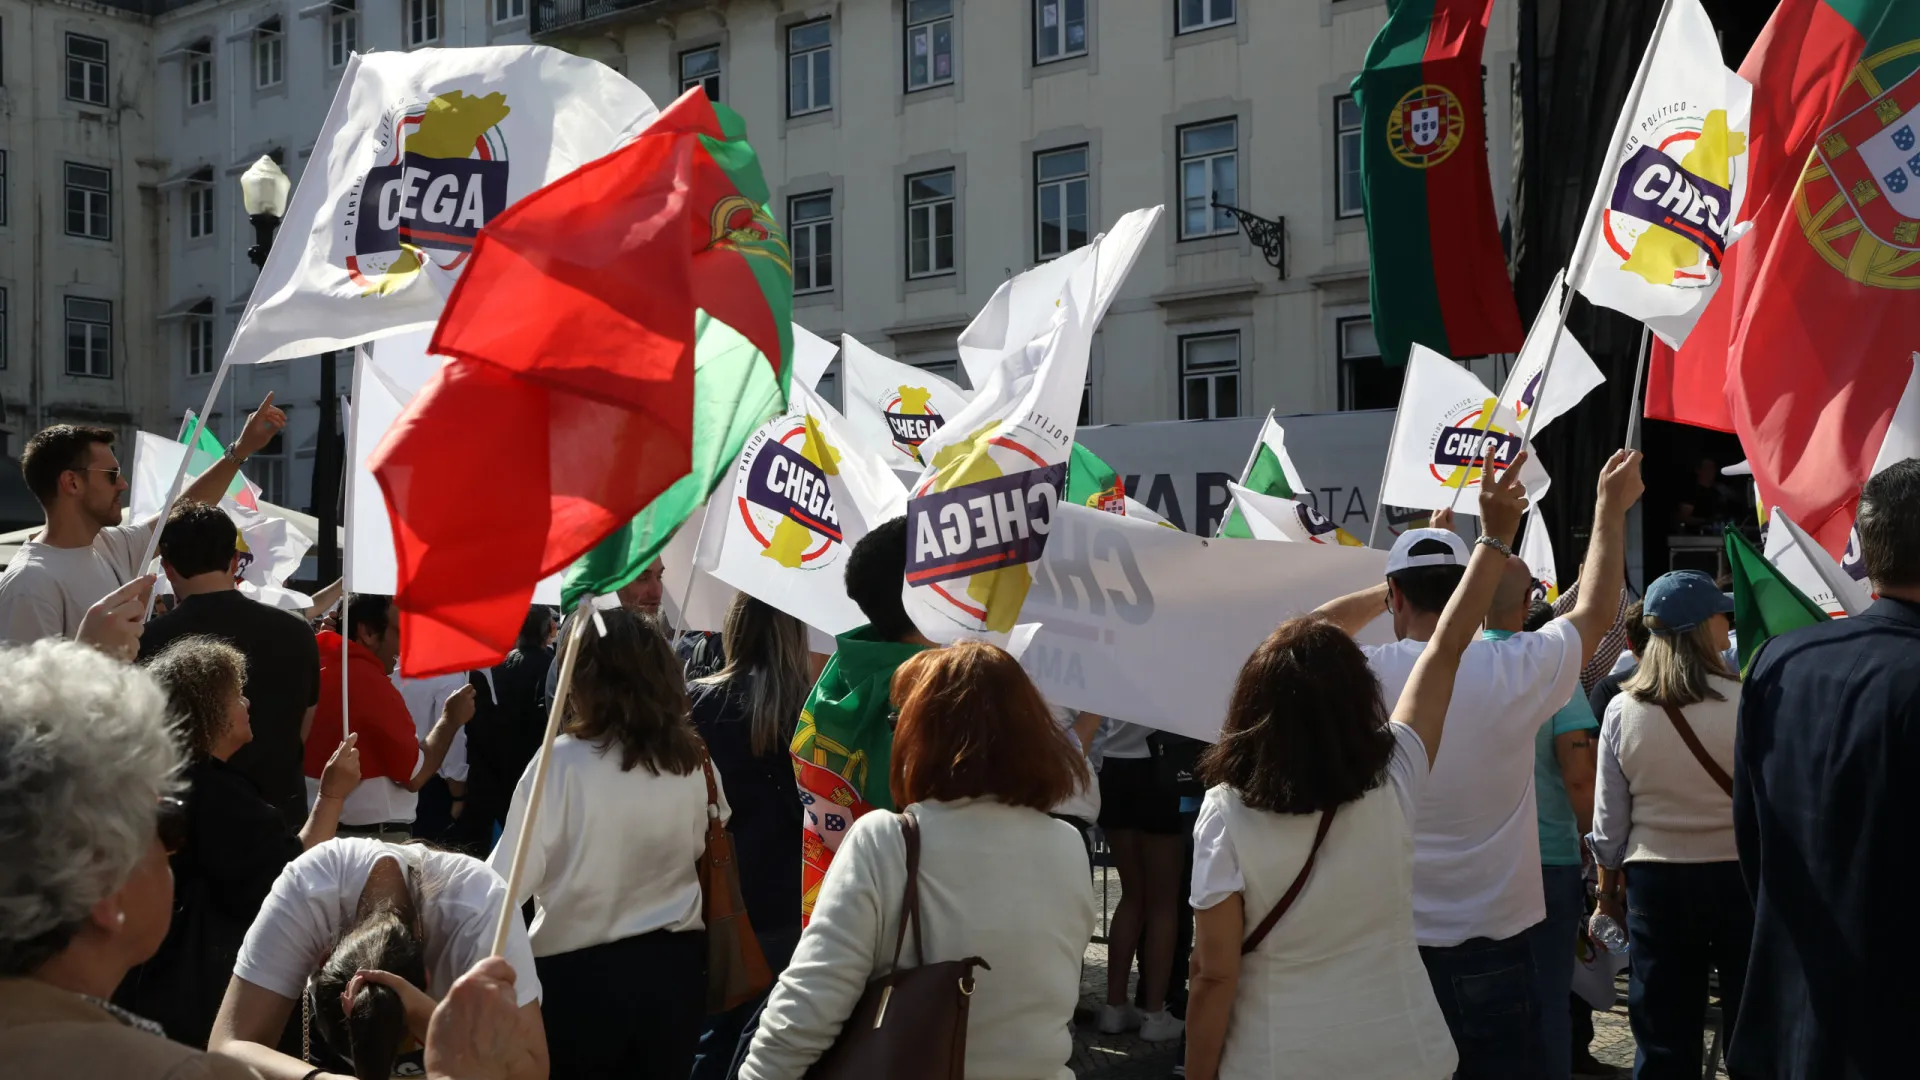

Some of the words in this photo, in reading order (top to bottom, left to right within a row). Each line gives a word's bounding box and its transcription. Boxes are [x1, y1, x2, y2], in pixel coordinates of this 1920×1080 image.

[1641, 101, 1687, 132] POLÍTICO
[889, 416, 940, 439] CHEGA
[740, 429, 766, 472] PARTIDO
[766, 454, 839, 526] CHEGA
